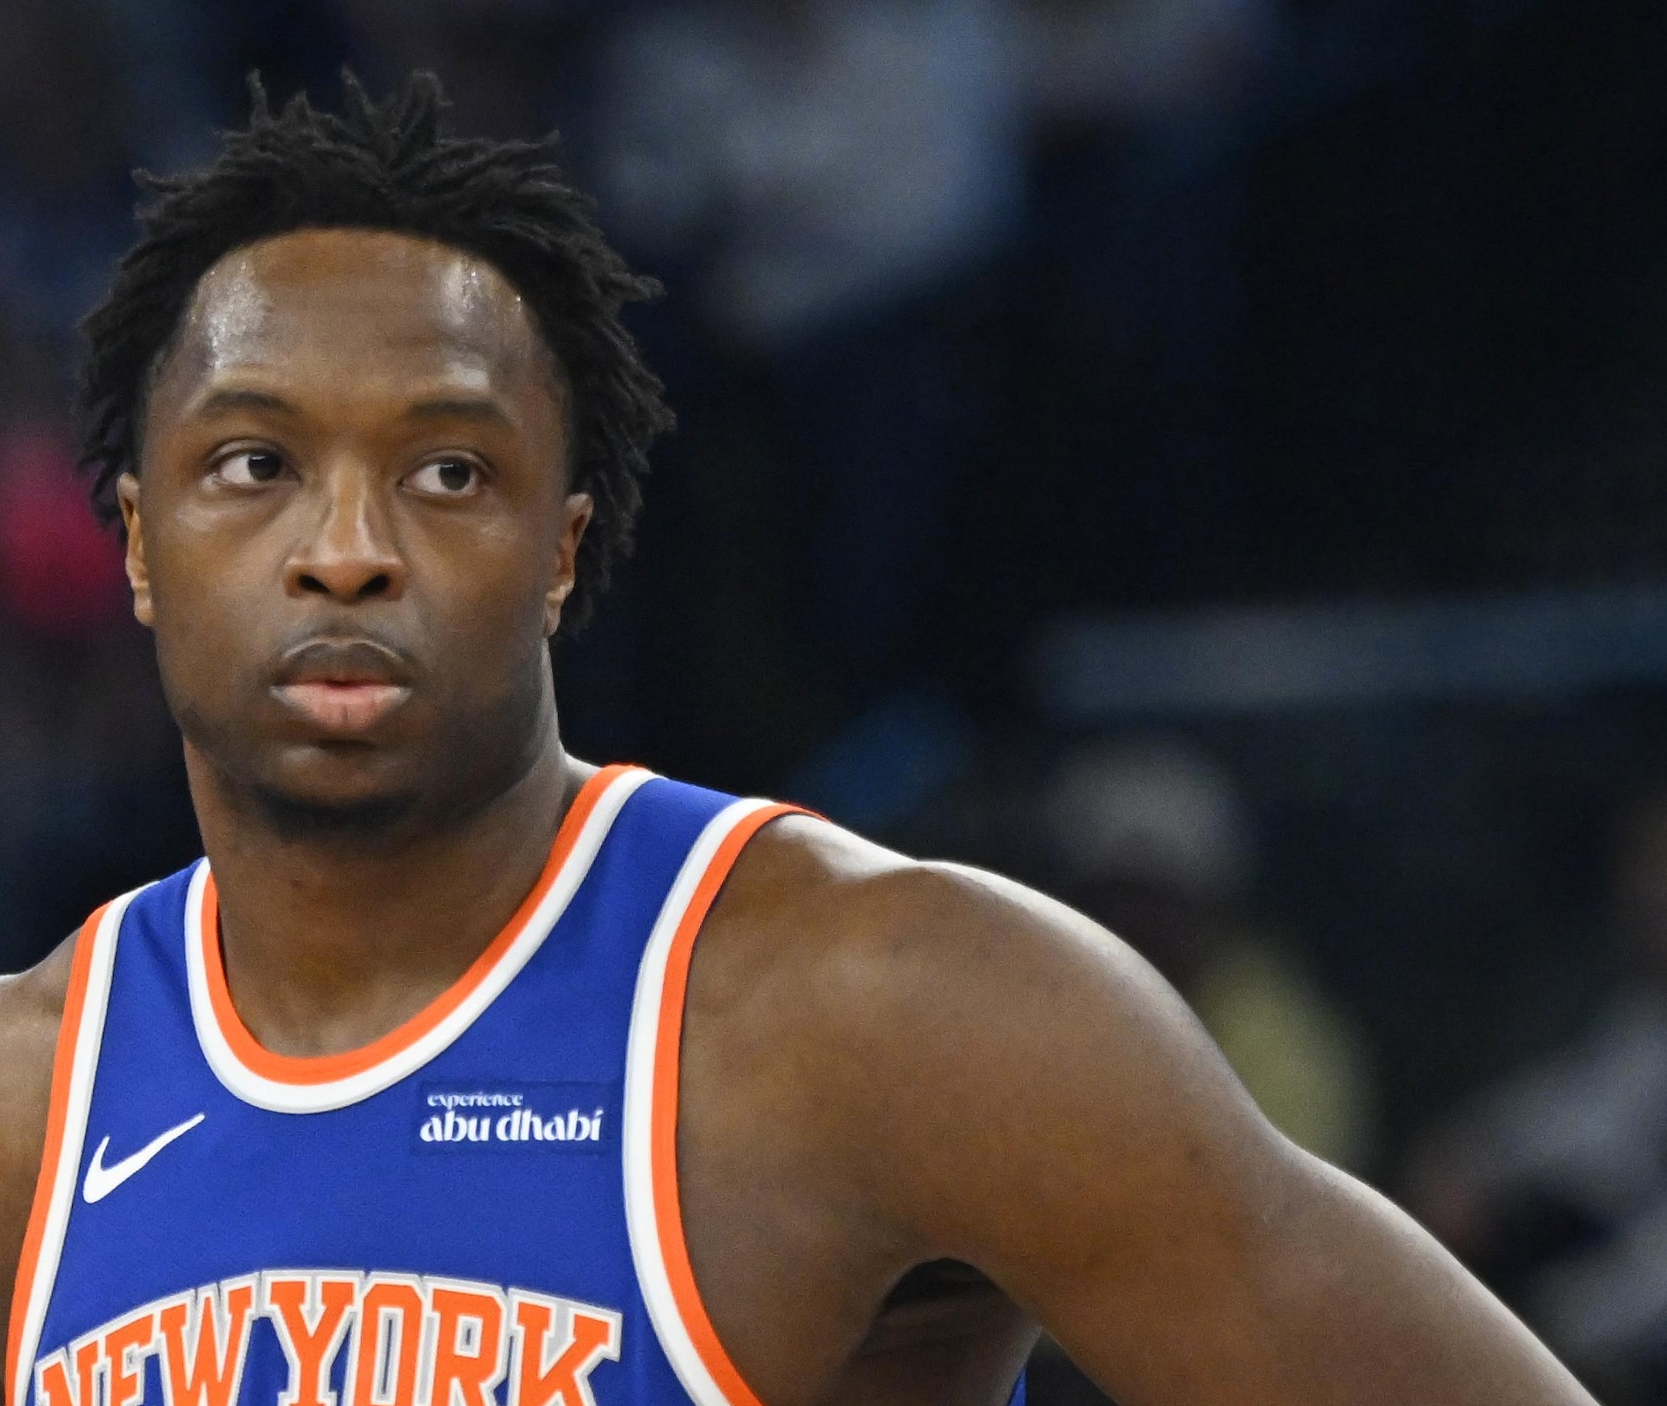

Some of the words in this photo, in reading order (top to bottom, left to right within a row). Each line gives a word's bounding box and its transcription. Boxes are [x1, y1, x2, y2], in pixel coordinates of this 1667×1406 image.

[427, 1091, 524, 1111] experience
[419, 1110, 491, 1143] abu
[496, 1106, 605, 1142] dhabi
